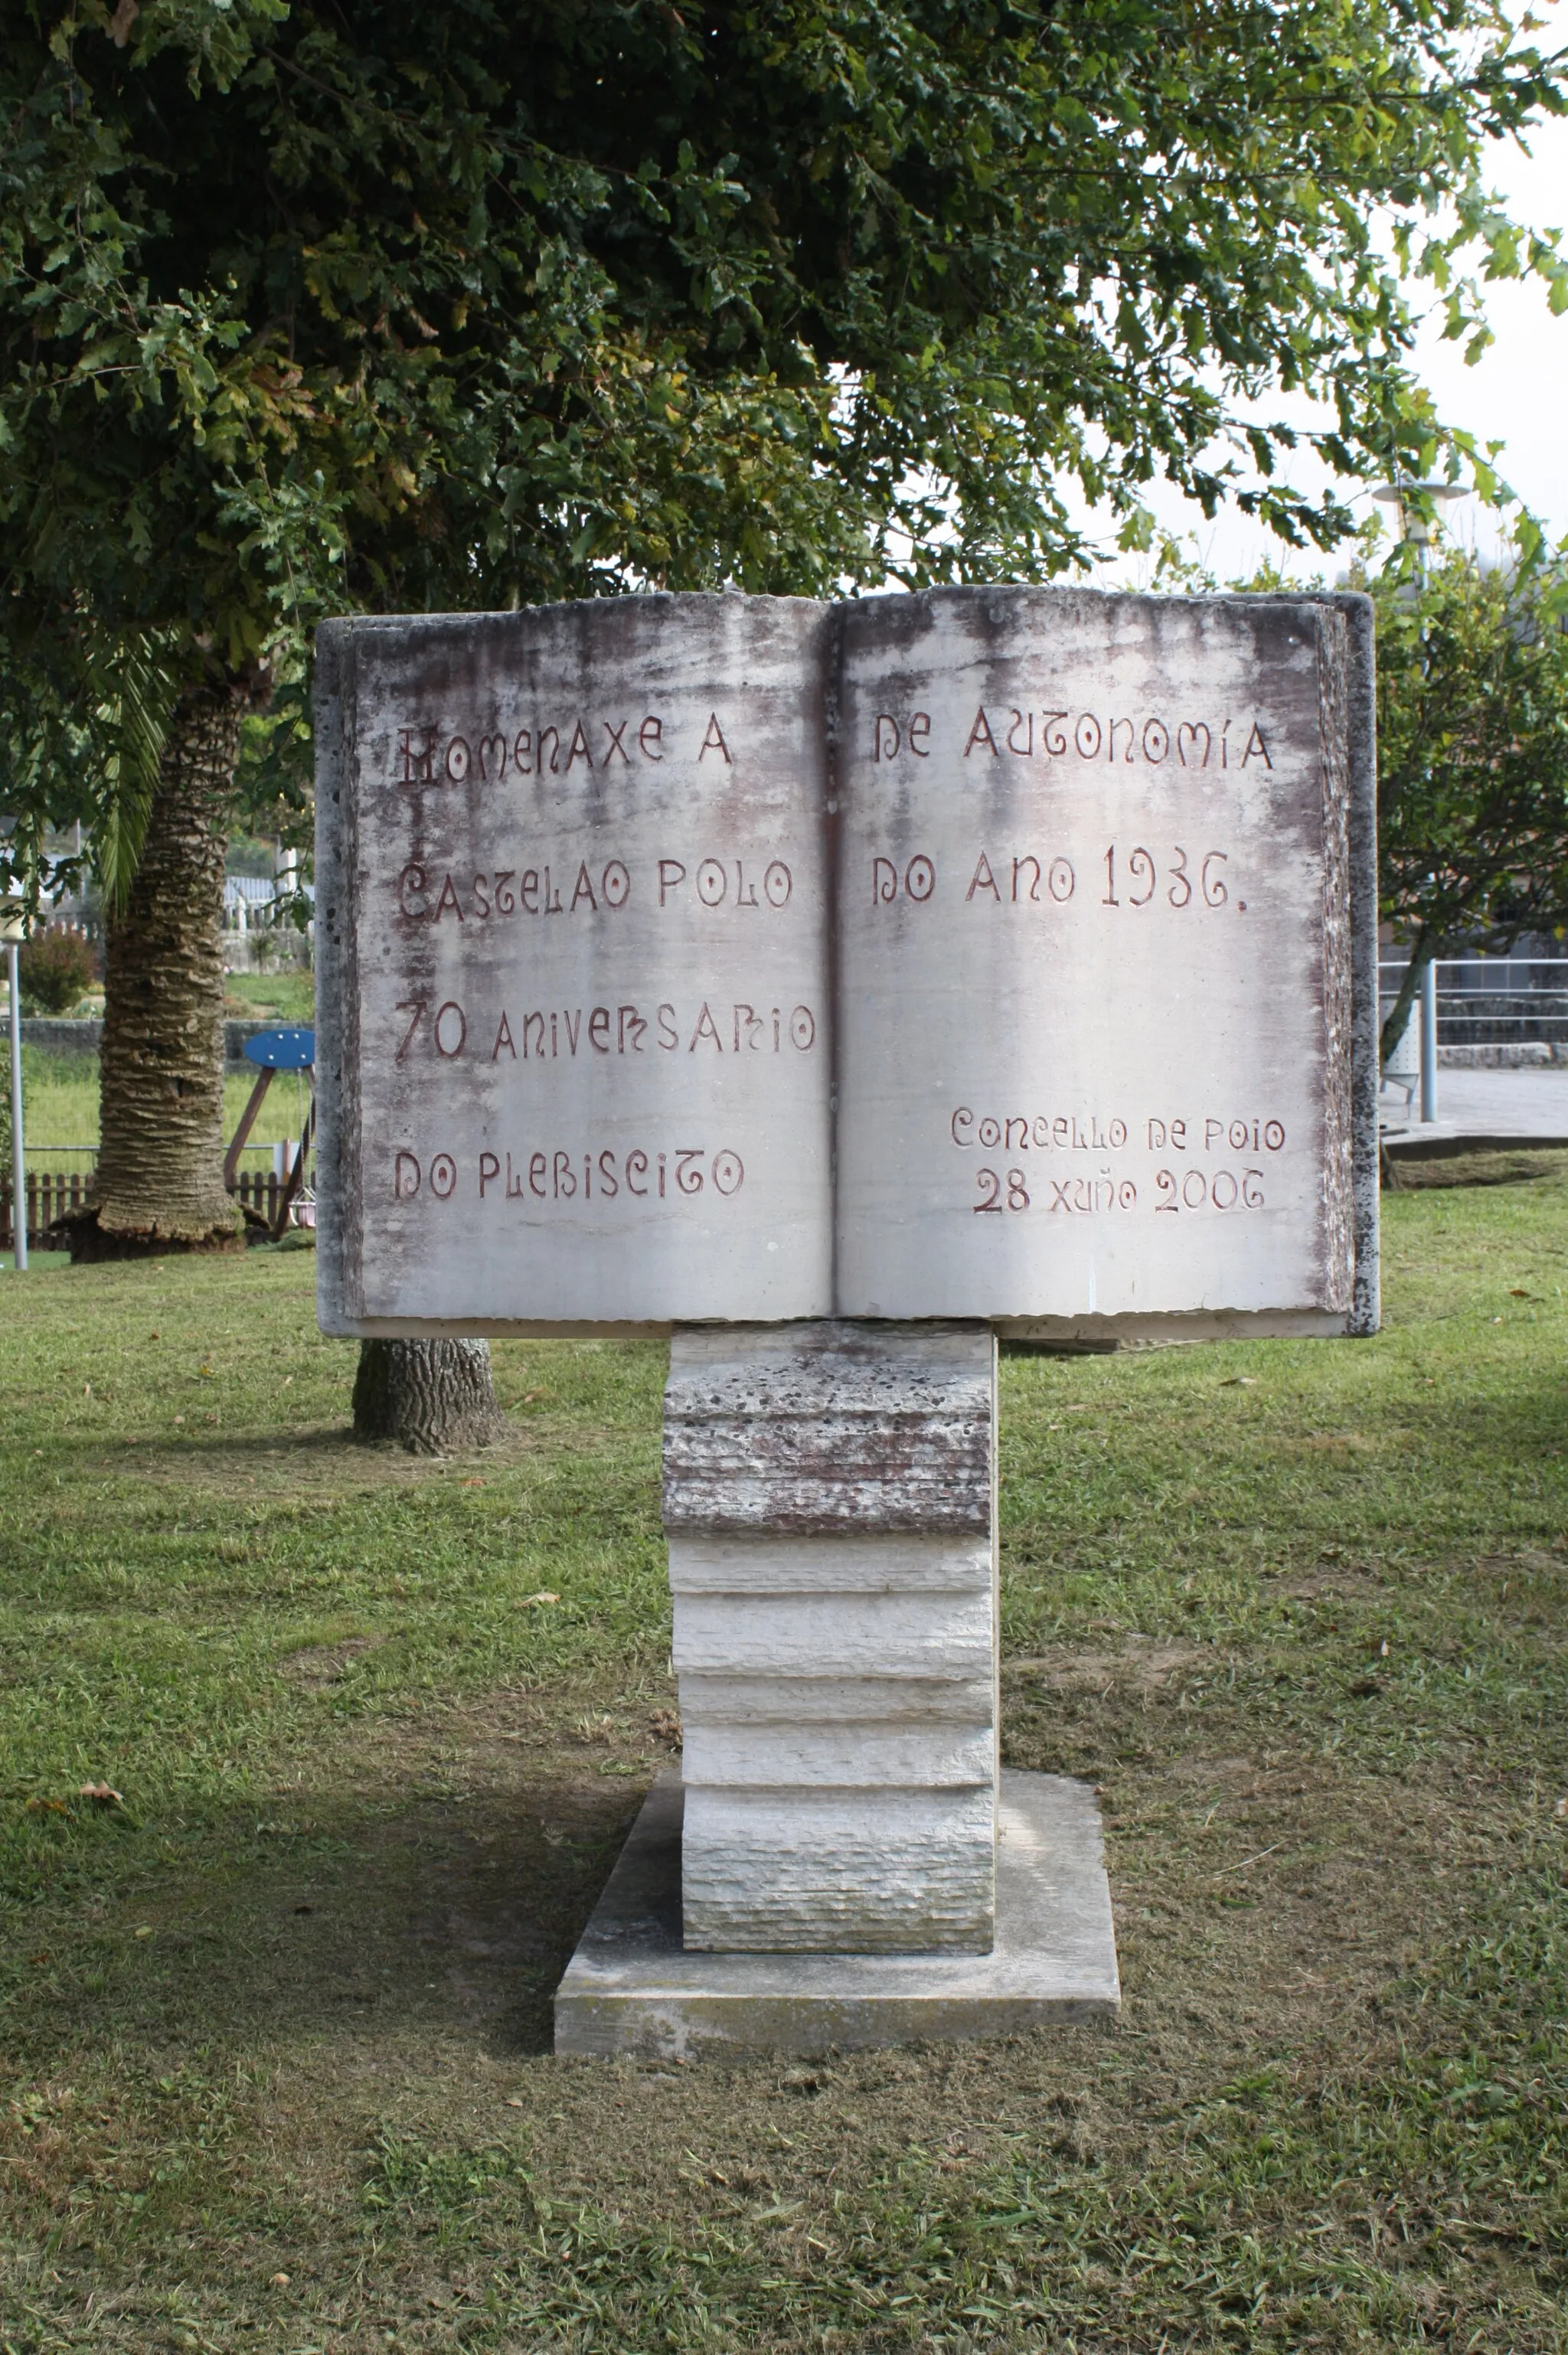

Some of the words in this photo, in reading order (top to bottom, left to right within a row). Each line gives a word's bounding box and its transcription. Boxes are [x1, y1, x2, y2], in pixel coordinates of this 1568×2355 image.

[697, 712, 732, 765] A
[874, 711, 931, 763] DE
[397, 859, 631, 921] CASTELAO
[657, 857, 793, 909] POLO
[872, 854, 936, 906] DO
[965, 850, 1075, 905] ANO
[1101, 844, 1247, 912] 1936.
[395, 1001, 467, 1066] 70
[1148, 1118, 1186, 1151] DE
[394, 1151, 457, 1200] DO
[973, 1168, 1030, 1214] 28
[1155, 1168, 1265, 1214] 2006
